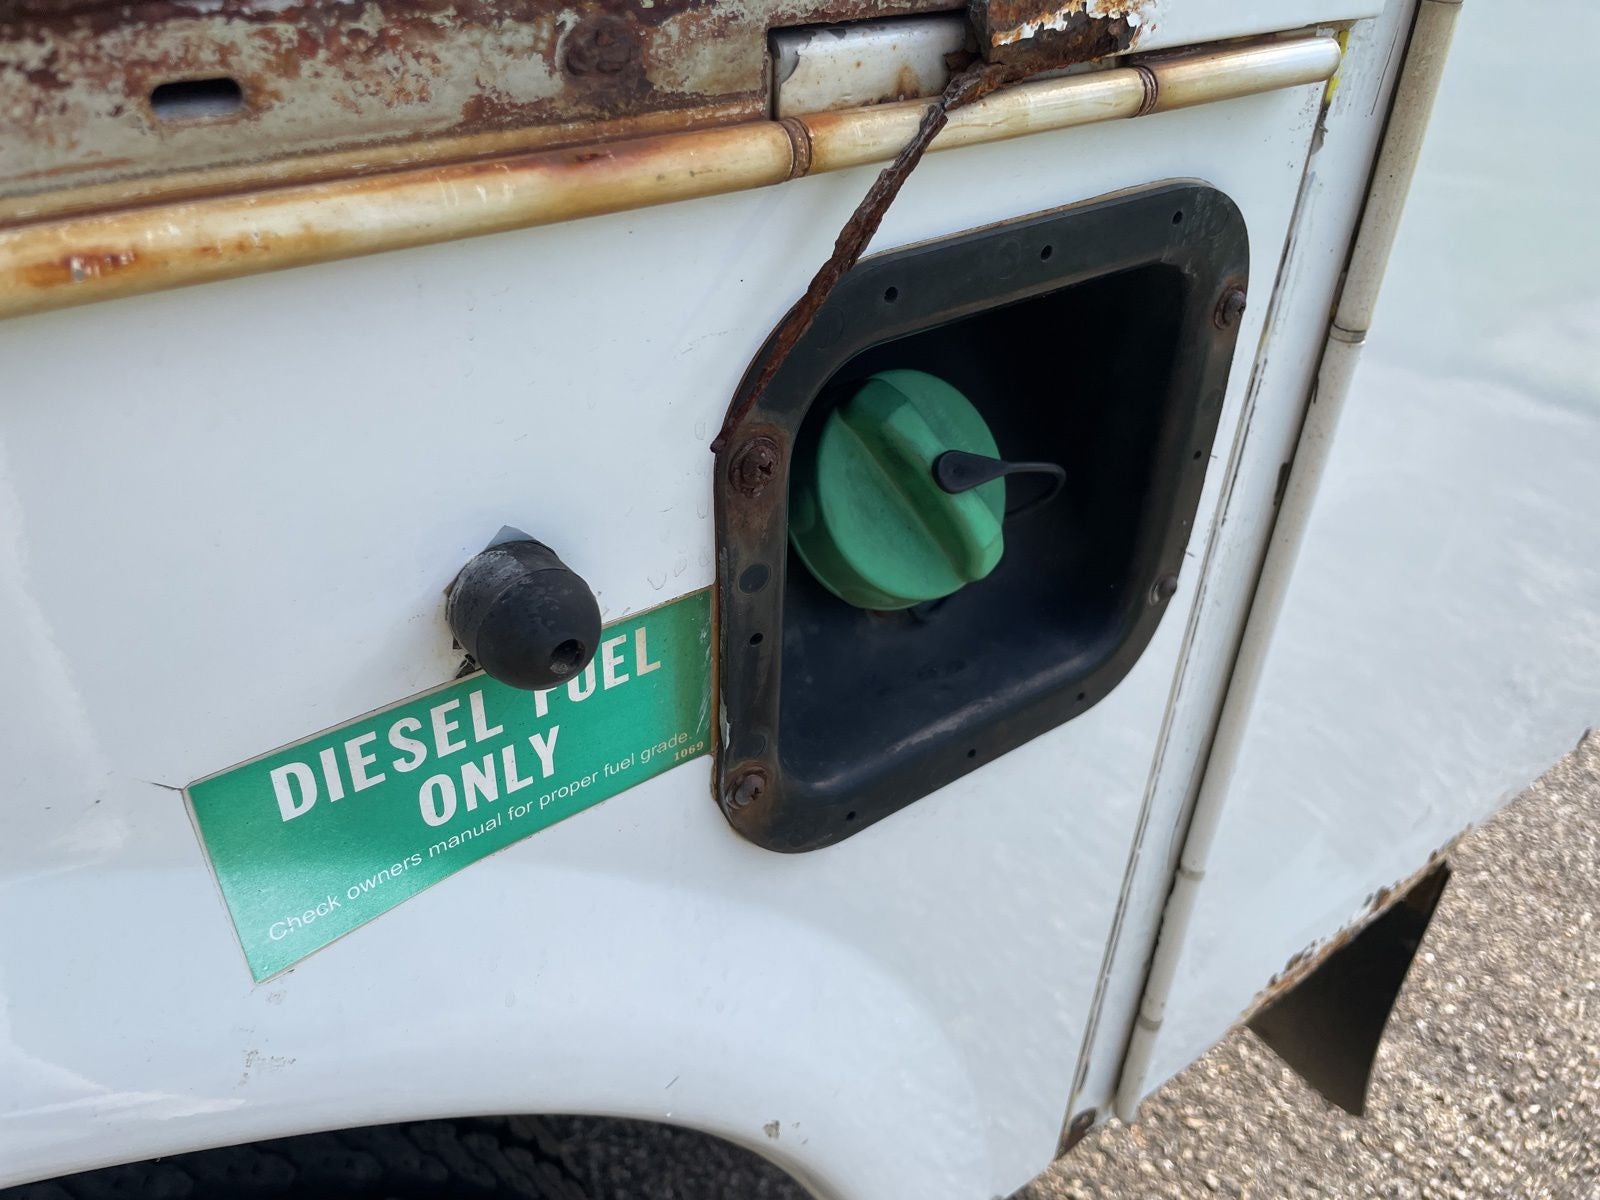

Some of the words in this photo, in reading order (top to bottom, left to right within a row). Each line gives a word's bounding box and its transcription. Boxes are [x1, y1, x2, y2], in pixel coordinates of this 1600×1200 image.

[270, 690, 503, 822] DIESEL
[419, 725, 560, 827] ONLY
[673, 741, 705, 761] 1069
[269, 894, 342, 941] Check
[346, 853, 422, 901] owners
[428, 812, 502, 858] manual
[508, 801, 533, 819] for
[539, 772, 597, 809] proper
[603, 752, 635, 775] fuel
[640, 732, 693, 764] grade.
